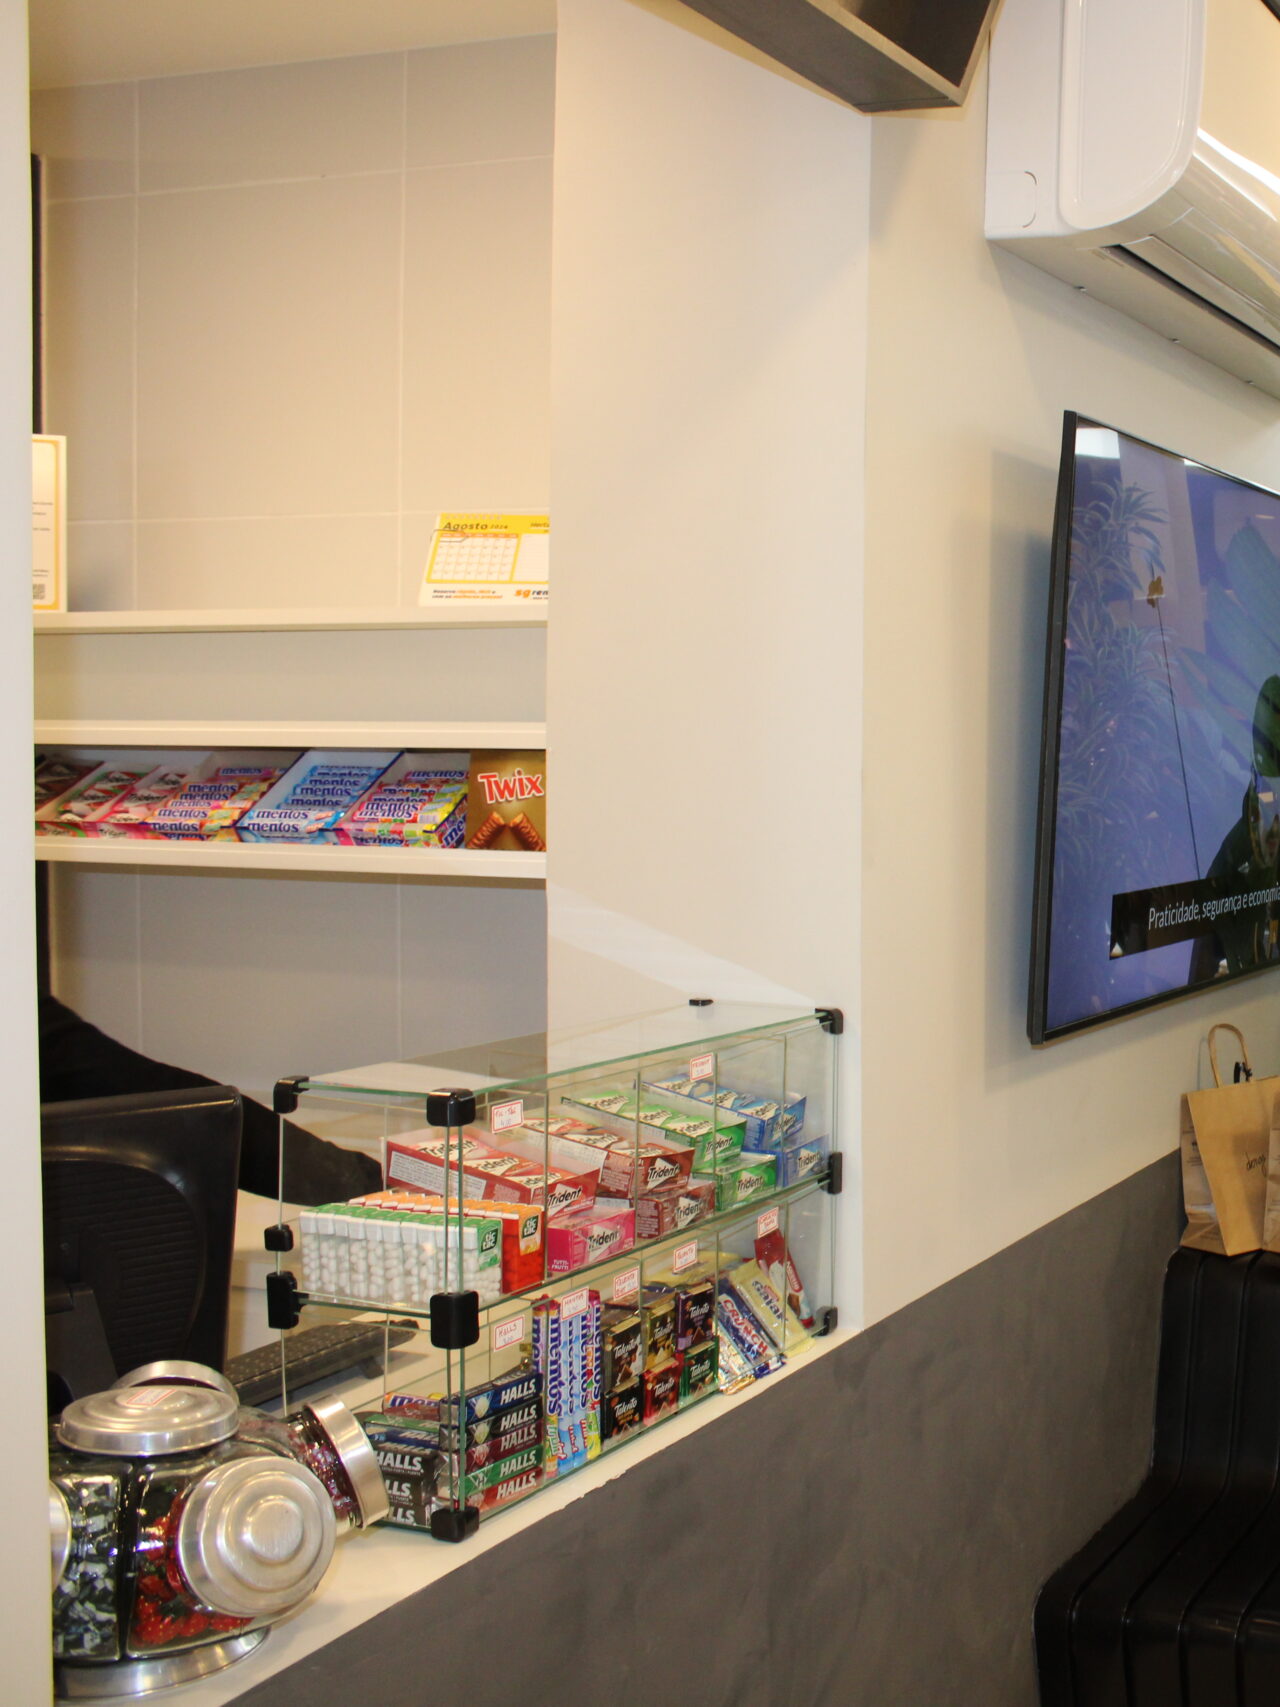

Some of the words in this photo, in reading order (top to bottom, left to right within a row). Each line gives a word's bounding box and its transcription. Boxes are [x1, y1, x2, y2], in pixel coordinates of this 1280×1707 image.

[443, 522, 488, 531] Agosto
[188, 784, 238, 793] mentos
[300, 786, 352, 797] mentos
[478, 768, 545, 804] Twix
[158, 808, 208, 818] mentos
[256, 810, 309, 819] mentos
[365, 801, 420, 812] mentos
[247, 822, 300, 833] mentos
[1148, 899, 1201, 930] Praticidade,
[1202, 893, 1242, 921] segurança
[1242, 895, 1248, 908] e
[648, 1162, 682, 1182] Trident
[737, 1175, 765, 1192] Trident
[548, 1185, 583, 1205] Trident
[523, 1226, 537, 1236] tac
[526, 1219, 537, 1229] tic
[482, 1238, 496, 1250] tac
[485, 1231, 496, 1241] tic
[588, 1231, 622, 1249] Trident
[689, 1302, 710, 1319] Talento
[654, 1322, 674, 1340] Talento
[723, 1299, 769, 1355] CRUNCH
[613, 1337, 637, 1358] Talento
[548, 1317, 565, 1417] mentos
[689, 1359, 711, 1377] Talento
[653, 1379, 675, 1398] Talento
[614, 1398, 638, 1418] Talento
